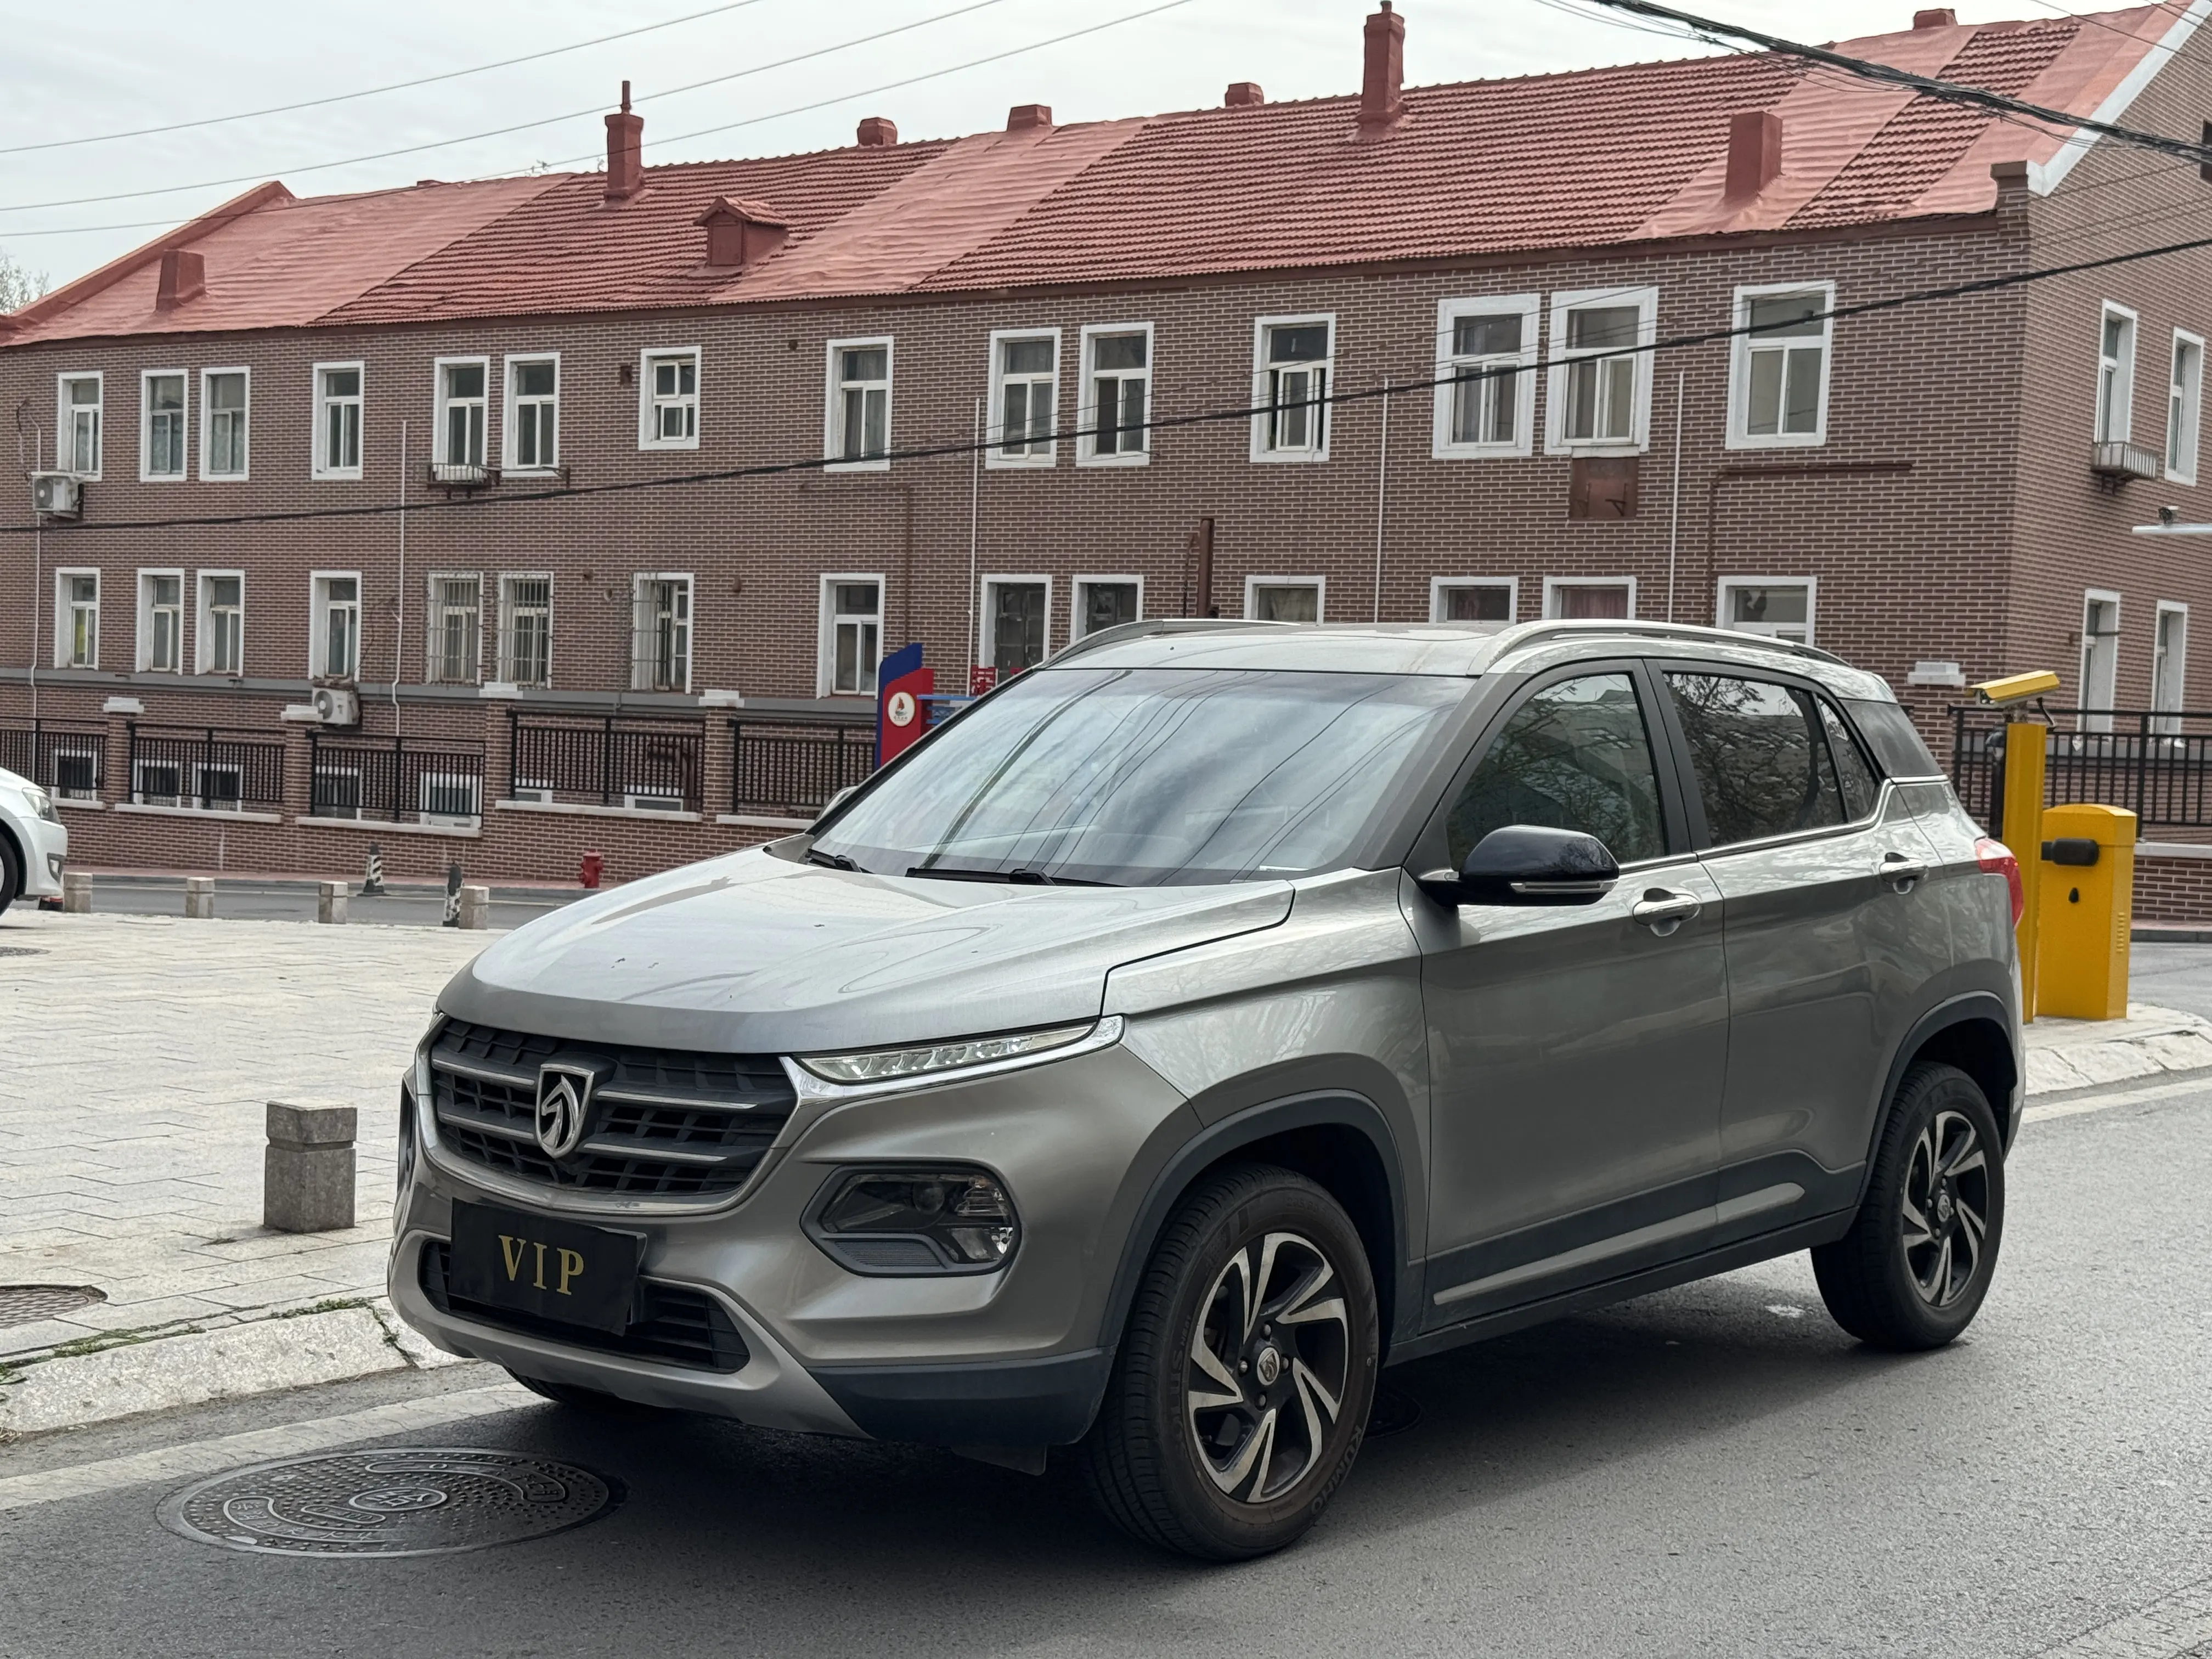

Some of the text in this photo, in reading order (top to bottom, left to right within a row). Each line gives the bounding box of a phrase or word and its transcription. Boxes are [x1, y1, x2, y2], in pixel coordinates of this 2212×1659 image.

[498, 1234, 584, 1296] VIP
[364, 1489, 432, 1508] 给
[1311, 1424, 1363, 1514] KUMHO
